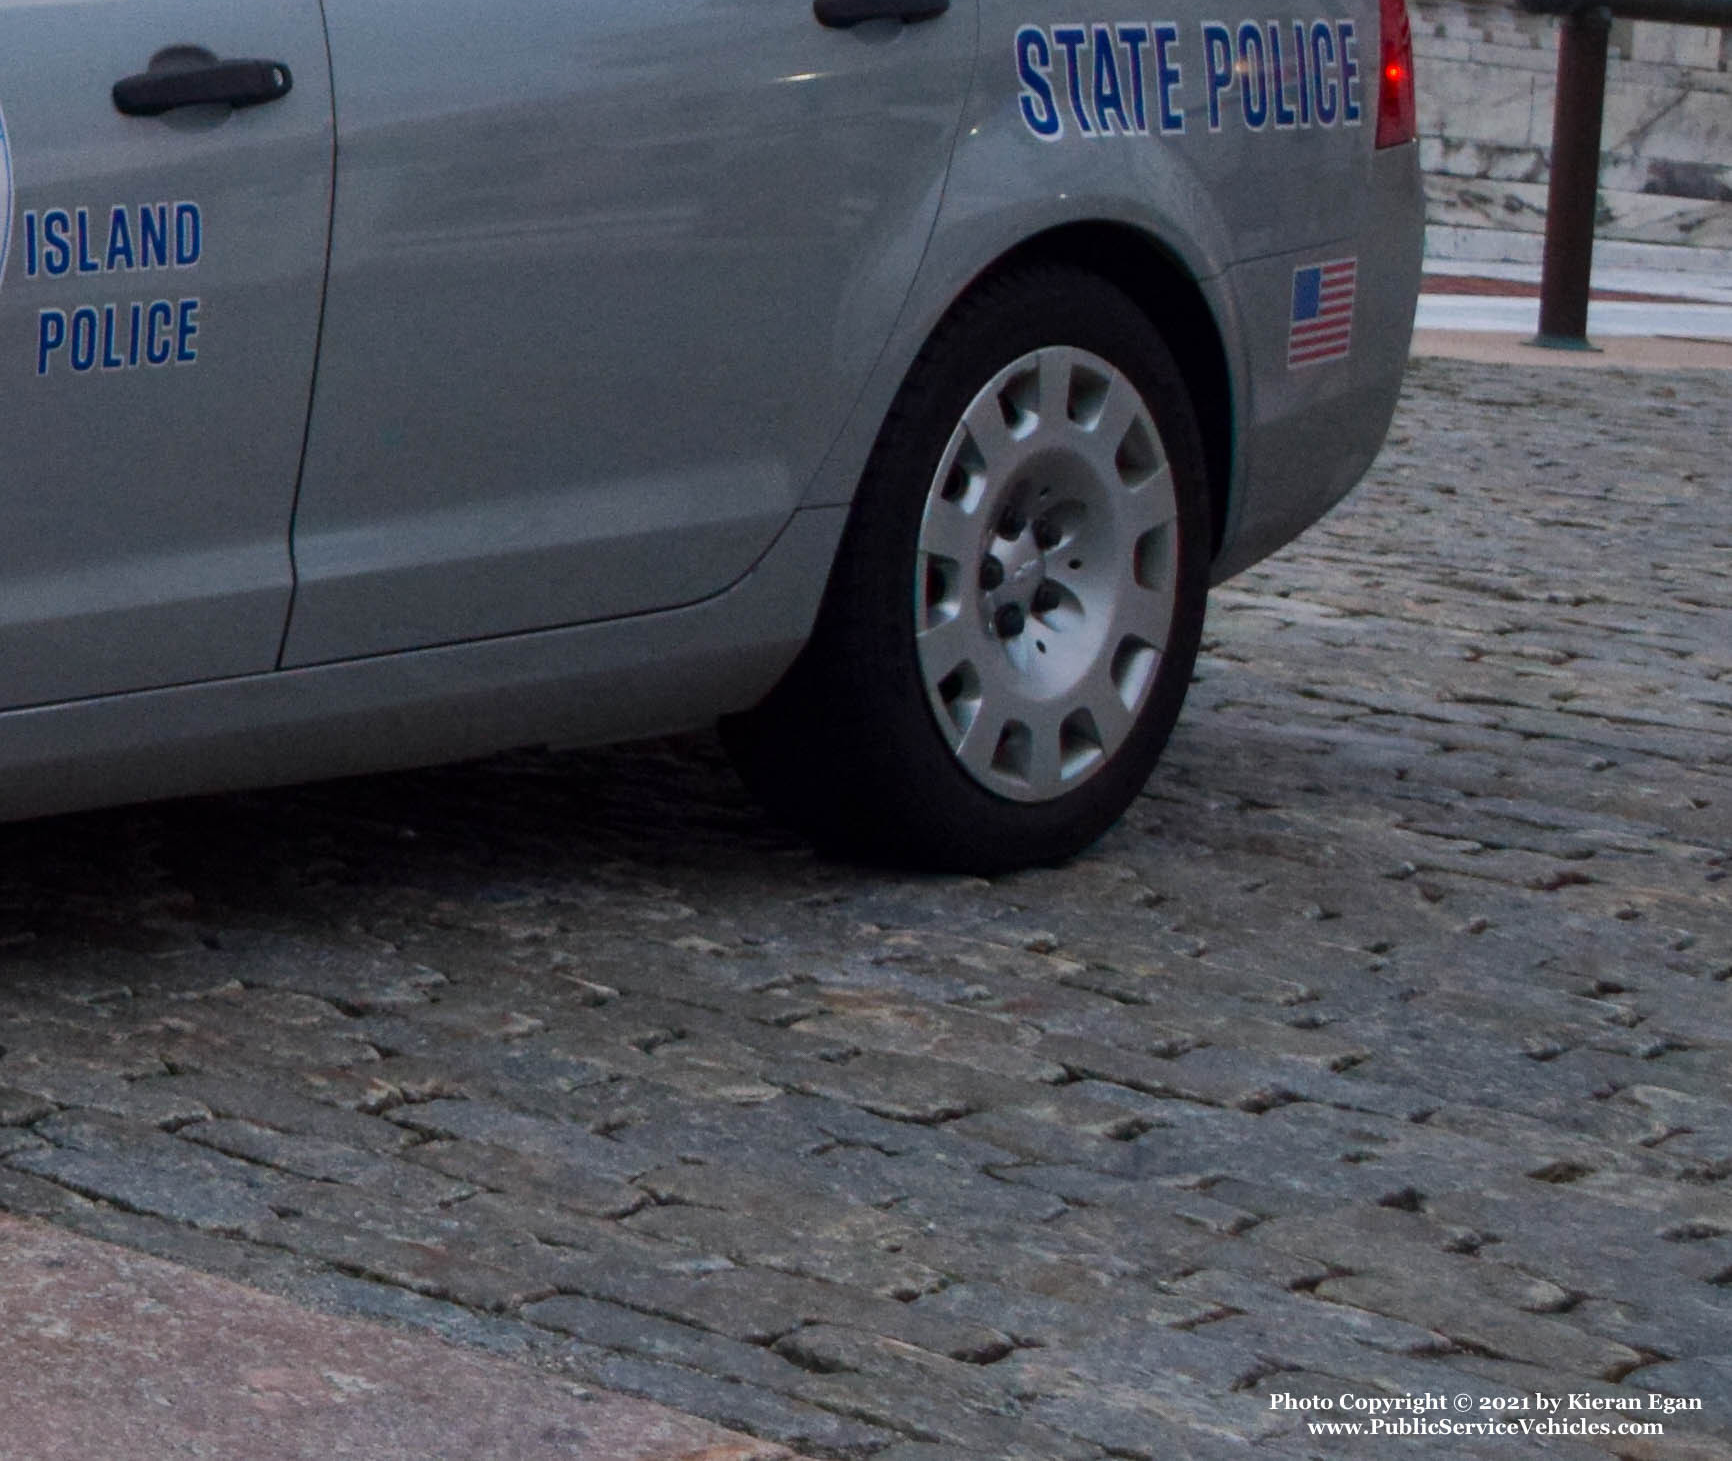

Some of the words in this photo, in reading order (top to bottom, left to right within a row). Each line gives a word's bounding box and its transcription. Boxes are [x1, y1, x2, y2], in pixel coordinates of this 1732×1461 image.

[1015, 21, 1185, 142] STATE
[1201, 18, 1361, 133] POLICE
[23, 200, 204, 279] ISLAND
[37, 298, 200, 376] POLICE
